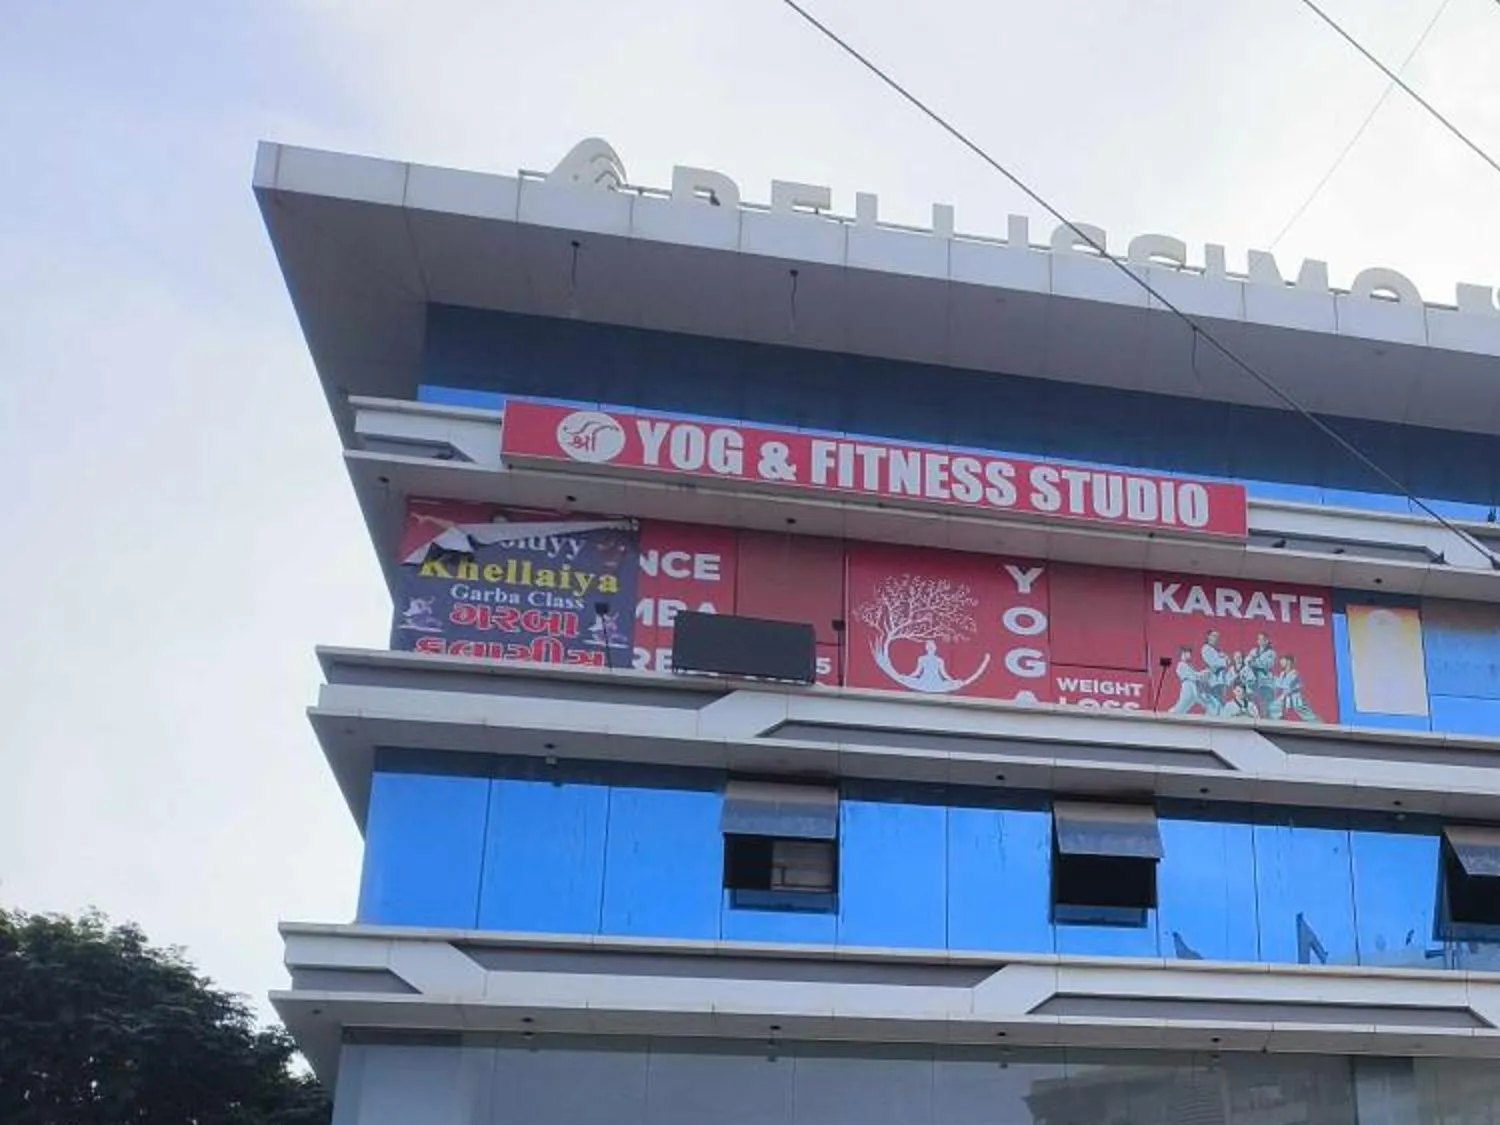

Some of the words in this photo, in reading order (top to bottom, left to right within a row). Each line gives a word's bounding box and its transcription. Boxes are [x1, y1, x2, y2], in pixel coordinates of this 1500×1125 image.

[634, 419, 744, 476] YOG
[758, 440, 797, 482] &
[811, 440, 1018, 504] FITNESS
[1029, 464, 1210, 528] STUDIO
[418, 558, 619, 597] Khellaiya
[639, 549, 721, 581] NCE
[450, 583, 520, 604] Garba
[1152, 581, 1326, 627] KARATE
[1056, 677, 1144, 697] WEIGHT
